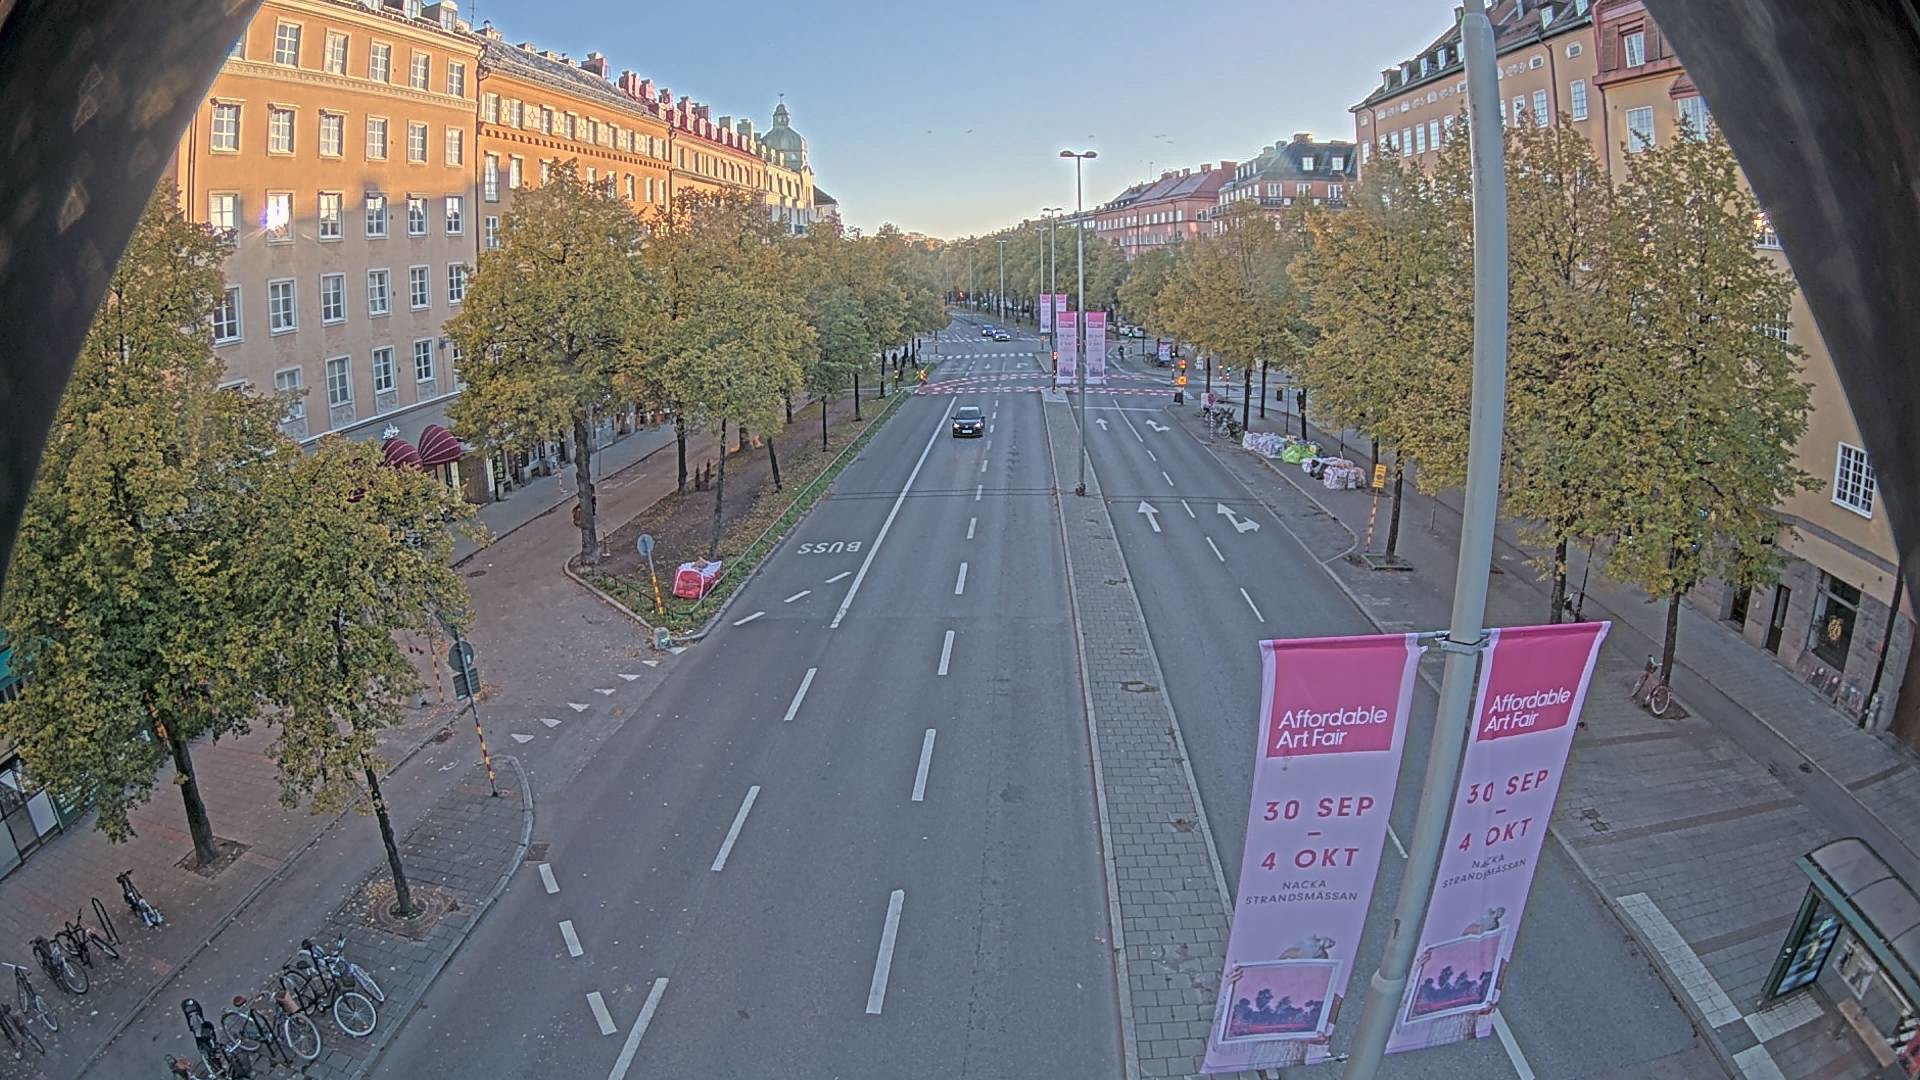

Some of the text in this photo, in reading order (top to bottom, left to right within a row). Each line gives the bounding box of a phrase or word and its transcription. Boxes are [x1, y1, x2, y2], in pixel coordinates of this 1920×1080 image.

[797, 541, 862, 555] BUSS
[1488, 687, 1571, 714] Affordable
[1278, 705, 1388, 729] Affordable
[1484, 709, 1539, 733] Art Fair
[1276, 728, 1347, 749] Art Fair
[1467, 769, 1549, 804] 30 SEP
[1263, 796, 1375, 821] 30 SEP
[1459, 818, 1533, 852] 4 OKT
[1261, 848, 1360, 870] 4 OKT
[1282, 879, 1327, 891] NACKA
